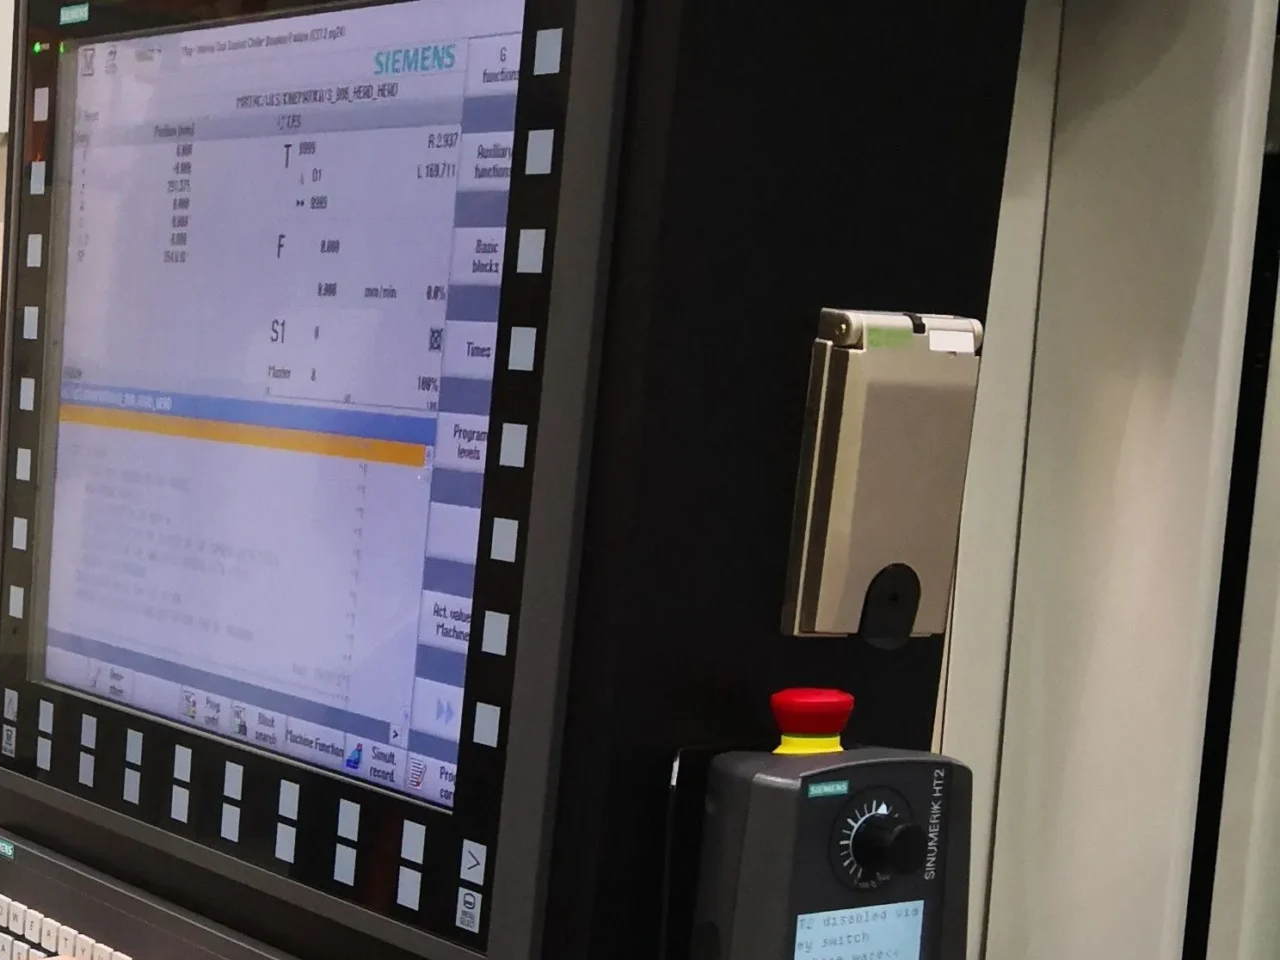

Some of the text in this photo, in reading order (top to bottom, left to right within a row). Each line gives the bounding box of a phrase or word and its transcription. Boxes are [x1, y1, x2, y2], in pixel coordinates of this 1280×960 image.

[373, 43, 456, 76] SIEMENS
[499, 46, 508, 62] G
[283, 143, 293, 169] T
[277, 234, 286, 259] F
[471, 259, 500, 274] blocks
[270, 318, 286, 344] S1
[466, 340, 491, 359] Times
[457, 445, 480, 461] levels
[285, 729, 314, 751] Machine
[371, 745, 397, 767] Simult.
[809, 781, 849, 795] SIEMENS
[924, 768, 946, 881] SINUMERIK HT2
[822, 910, 888, 928] disabled
[895, 907, 919, 919] via
[821, 931, 870, 948] switch
